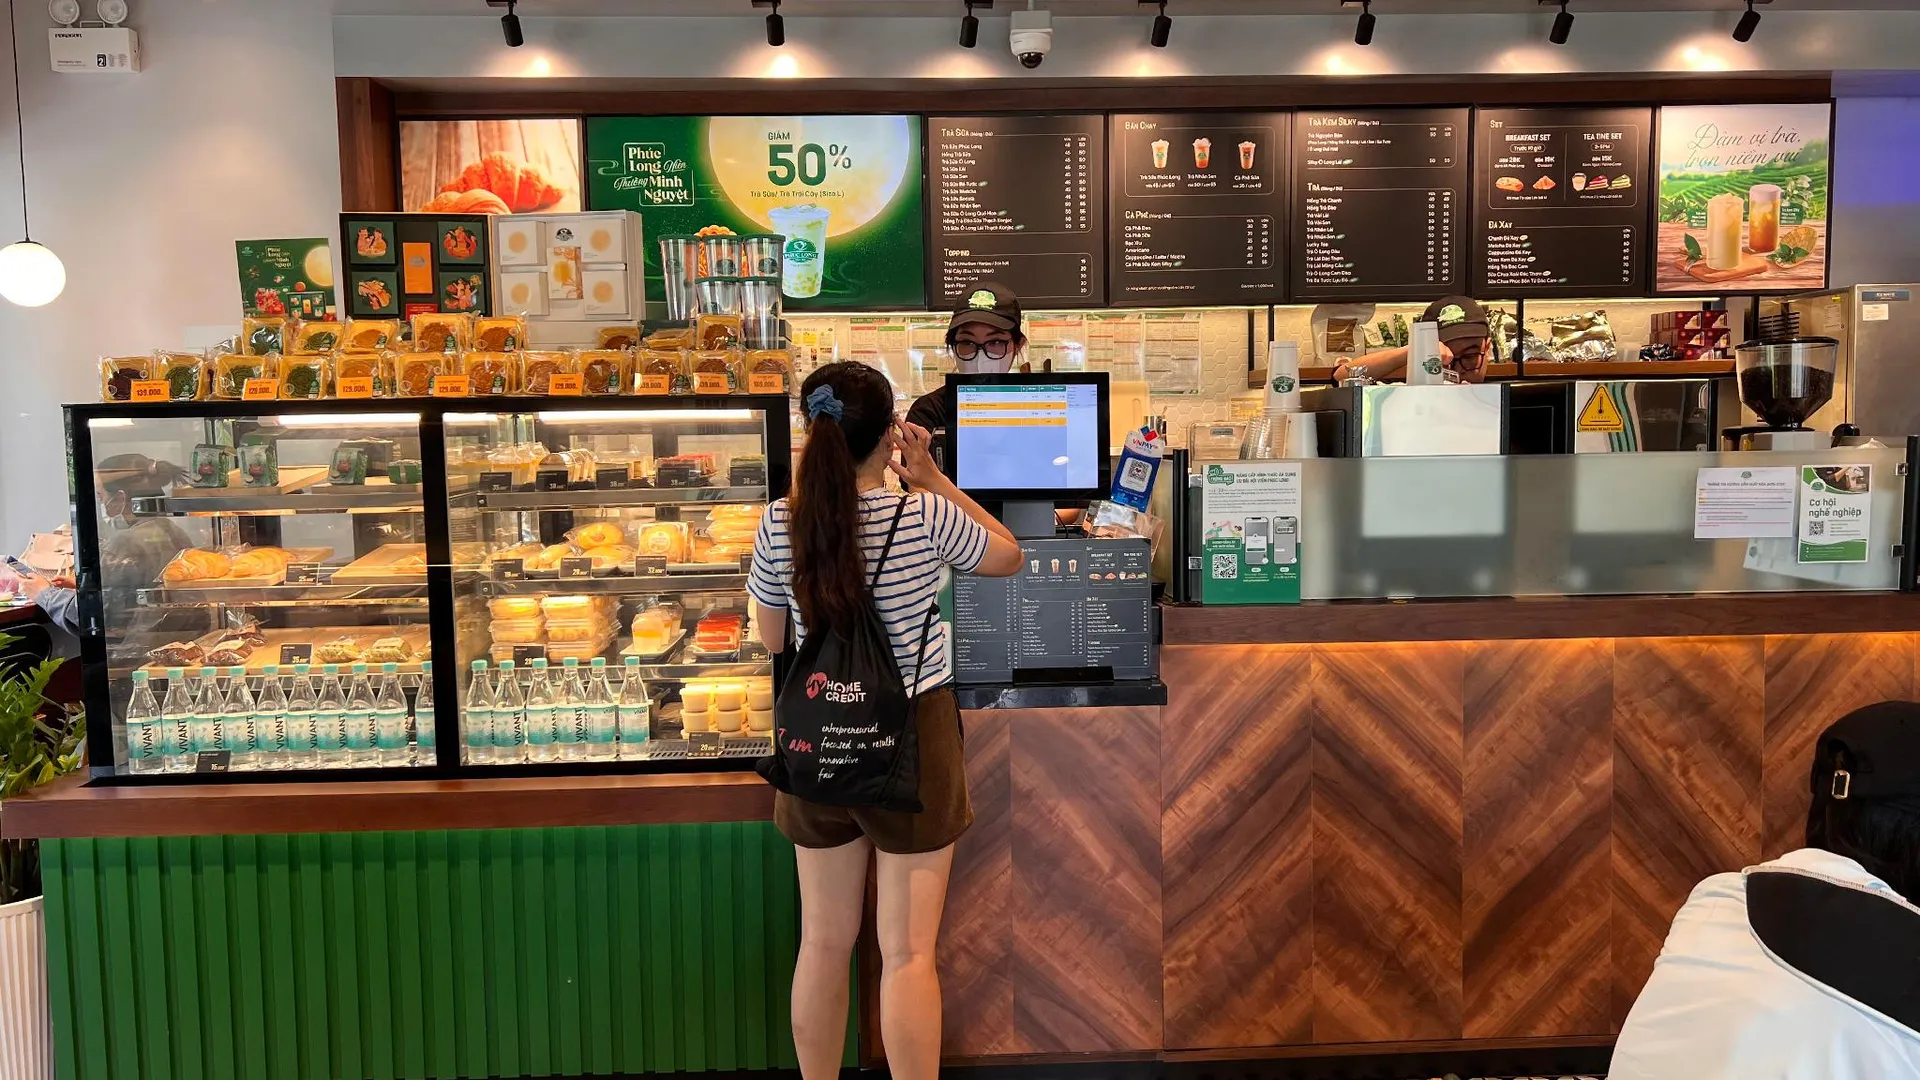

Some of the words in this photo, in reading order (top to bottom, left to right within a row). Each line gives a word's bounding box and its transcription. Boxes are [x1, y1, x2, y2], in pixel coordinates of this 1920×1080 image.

[1505, 134, 1539, 142] BREAKFAST
[1539, 134, 1552, 142] SET
[628, 146, 662, 160] Phúc
[628, 160, 662, 176] Long
[767, 143, 852, 187] 50%
[649, 175, 684, 188] Minh
[644, 188, 690, 204] Nguyệt
[1809, 499, 1821, 507] Cơ
[1823, 498, 1836, 508] hội
[1809, 507, 1830, 519] nghề
[1832, 507, 1862, 519] nghiệp
[826, 680, 862, 693] HOME
[825, 691, 867, 703] CREDIT
[275, 714, 286, 749] VIVANT
[308, 714, 318, 749] VIVANT
[338, 713, 348, 749] VIVANT
[367, 712, 377, 748] VIVANT
[513, 711, 522, 746] VIVANT
[575, 708, 584, 742] VIVANT
[821, 722, 879, 735] entrepreneurial
[142, 722, 154, 758] VIVANT
[178, 719, 190, 754] VIVANT
[247, 716, 258, 751] VIVANT
[820, 738, 852, 752] focused
[857, 741, 867, 749] on
[872, 737, 895, 749] results
[819, 755, 859, 764] innovative
[818, 770, 835, 783] fair
